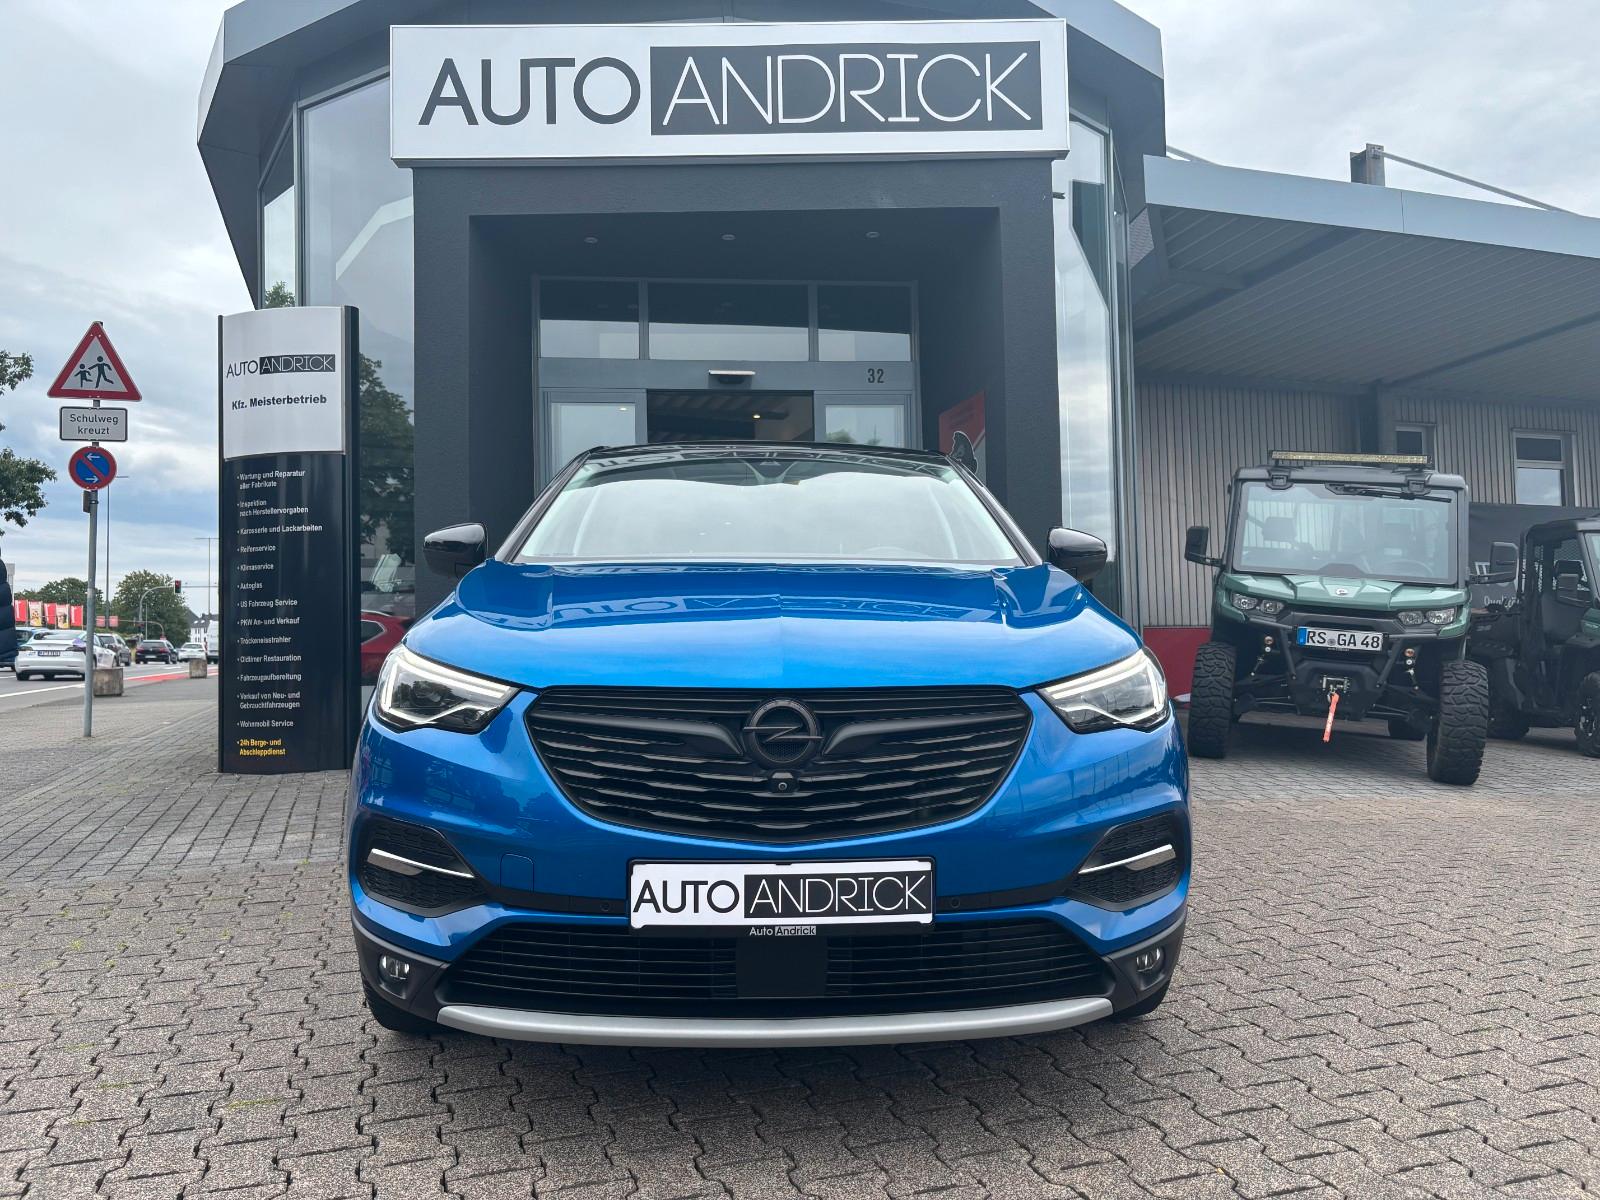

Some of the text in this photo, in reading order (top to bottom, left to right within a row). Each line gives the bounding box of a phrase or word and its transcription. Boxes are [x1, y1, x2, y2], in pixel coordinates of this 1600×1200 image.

[418, 51, 1033, 126] AUTO ANDRICK
[226, 354, 335, 379] AUTO ANDRICK
[867, 368, 885, 384] 32
[231, 394, 327, 411] Kfz. Meisterbetrieb
[70, 413, 119, 425] Schulweg
[77, 425, 110, 435] kreuzt
[262, 471, 274, 479] und
[274, 470, 306, 479] Reparatur
[251, 480, 277, 489] Fabrikate
[252, 506, 309, 516] Herstellervorgaben
[240, 524, 323, 535] Karosserie und Lackarbeiten
[240, 544, 276, 553] Reifenservice
[240, 582, 263, 590] Autoglas
[240, 598, 298, 608] US Fahrzeug Service
[276, 616, 300, 625] Verkauf
[1306, 630, 1380, 649] RS GA 48
[240, 654, 302, 663] Oldtimer Restauration
[240, 673, 302, 683] Fahrzeugaufbereitung
[240, 692, 260, 700] Verkauf
[287, 691, 300, 699] und
[240, 701, 300, 709] Gebrauchtfahrzeugen
[240, 719, 294, 728] Wohnmobil Service
[240, 738, 282, 747] 24h Berge- und
[240, 748, 286, 756] Abschleppdienst
[633, 875, 927, 914] AUTO ANDRICK
[749, 925, 816, 936] Auto Andrick
